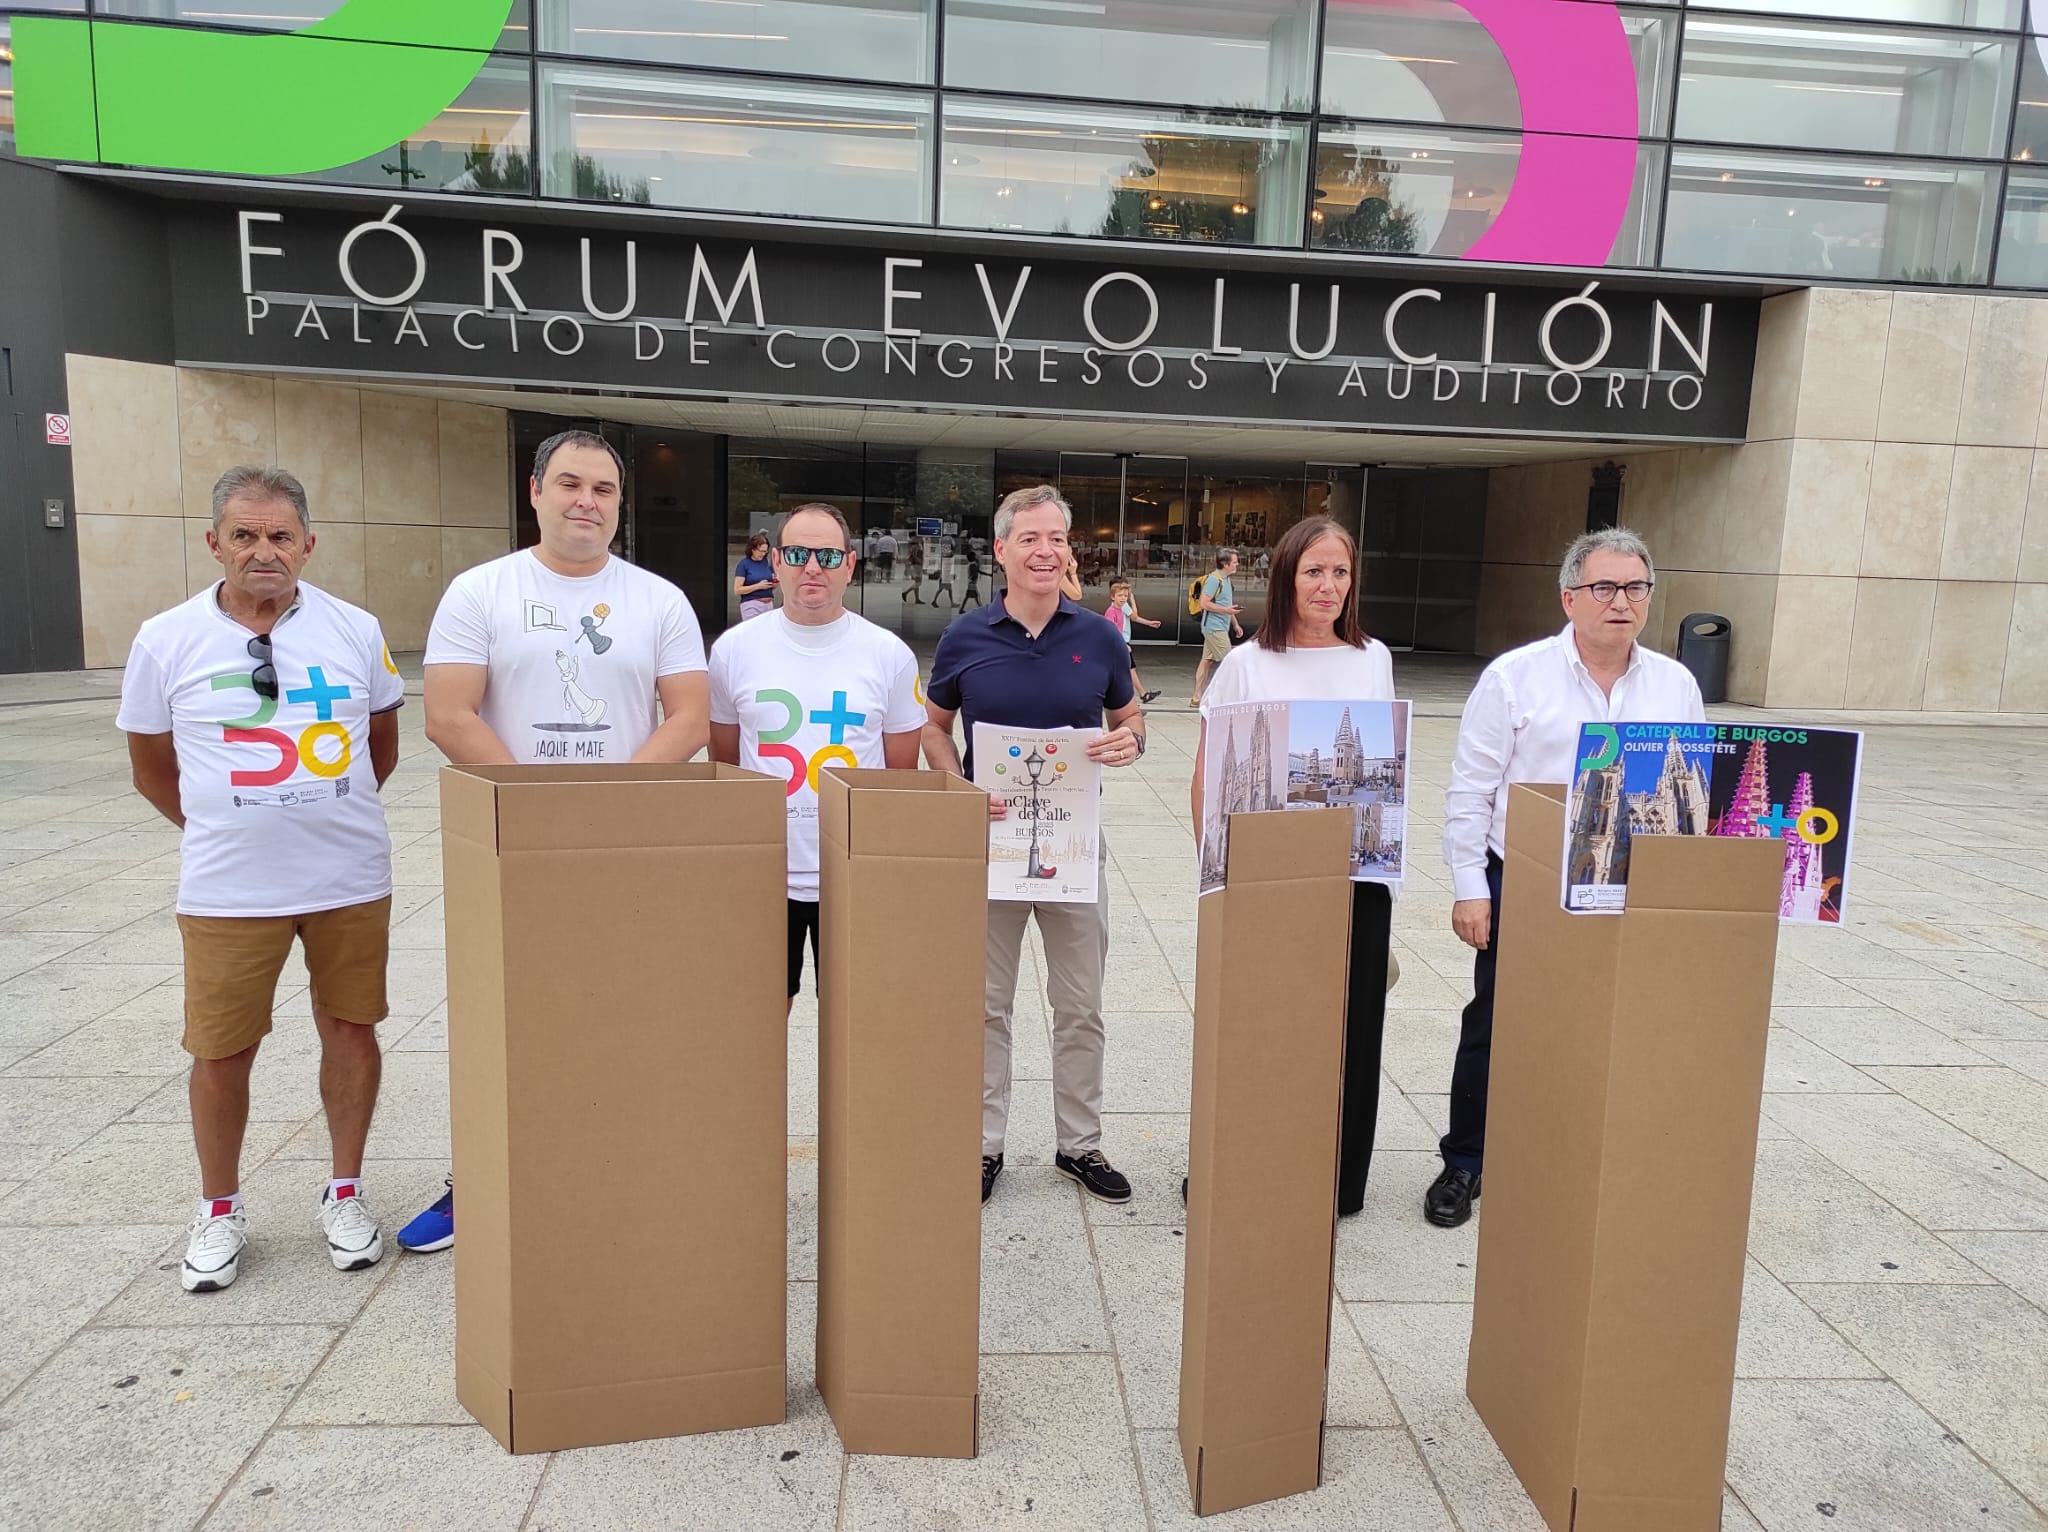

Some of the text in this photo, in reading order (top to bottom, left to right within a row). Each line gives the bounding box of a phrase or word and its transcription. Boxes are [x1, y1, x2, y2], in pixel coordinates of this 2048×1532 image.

[237, 205, 1713, 376] FÓRUM EVOLUCIÓN
[246, 295, 1704, 411] PALACIO DE CONGRESOS Y AUDITORIO
[1625, 724, 1808, 744] CATEDRAL DE BURGOS
[533, 740, 605, 758] JAQUE MATE
[1624, 742, 1664, 752] OLIVIER
[1016, 827, 1055, 838] BURGOS
